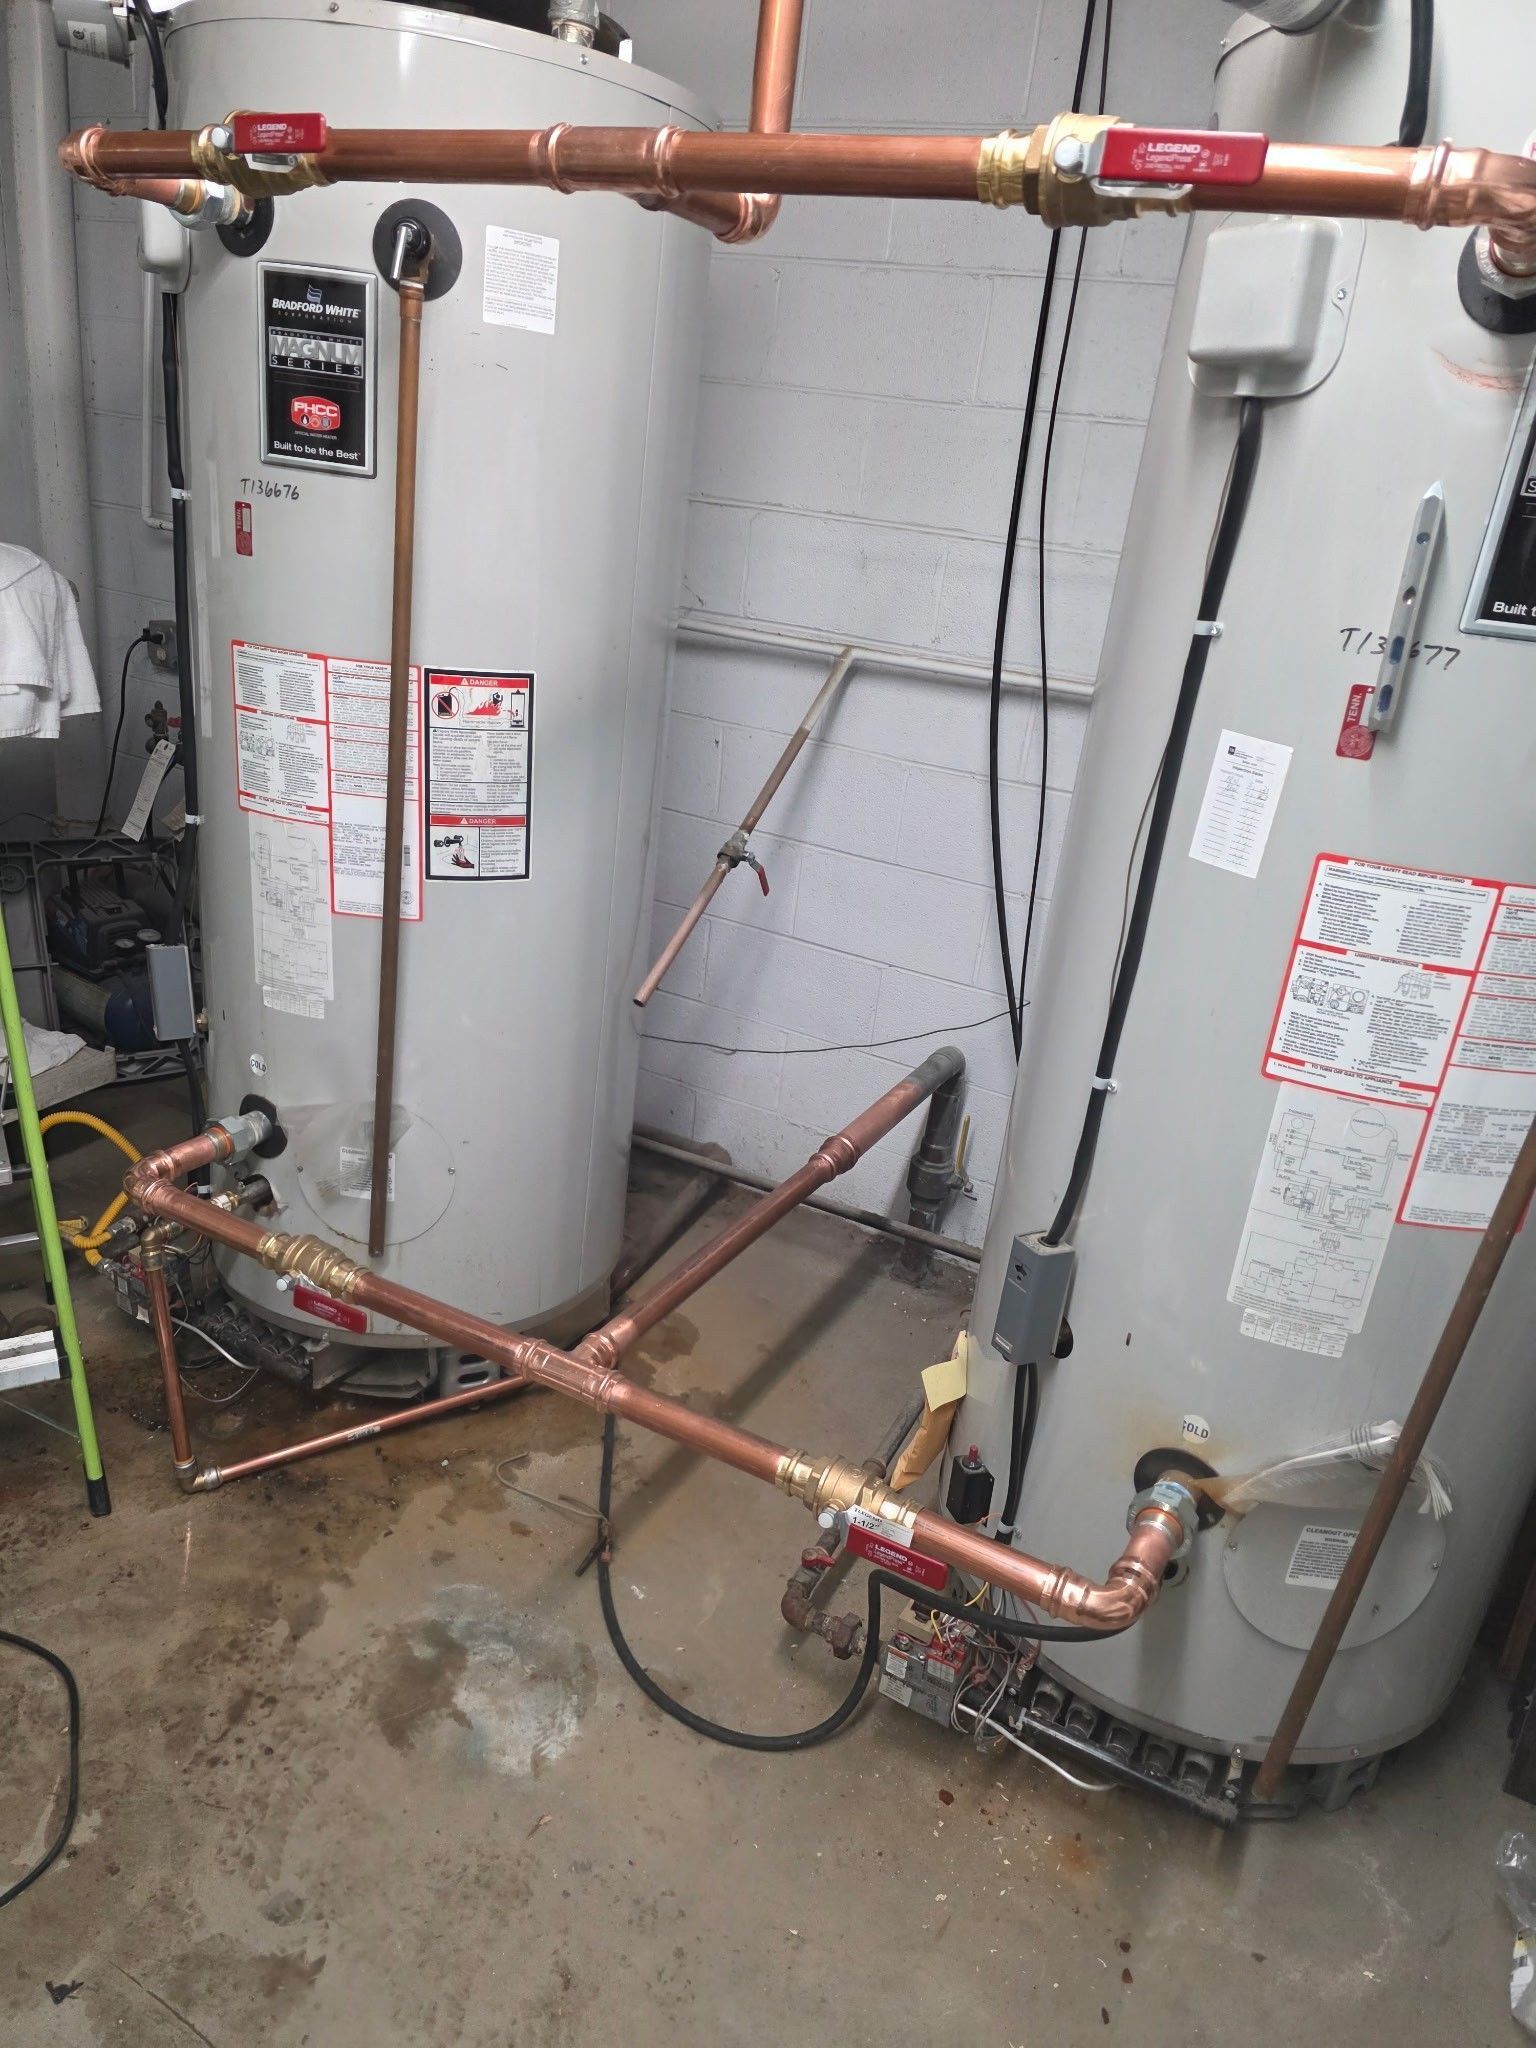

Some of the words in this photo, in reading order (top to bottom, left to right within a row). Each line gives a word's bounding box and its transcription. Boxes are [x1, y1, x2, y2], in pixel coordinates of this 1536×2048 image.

[257, 123, 288, 131] LEGEND
[1147, 142, 1201, 154] LEGEND
[272, 298, 323, 314] BRADFORD
[325, 304, 359, 318] WHITE
[278, 311, 352, 324] CORPORATION
[271, 335, 362, 365] MAGNUM
[272, 355, 360, 376] SERIES
[293, 401, 338, 417] PHCC
[273, 440, 292, 451] Built
[294, 443, 303, 452] to
[304, 445, 317, 454] be
[319, 447, 334, 457] the
[336, 449, 359, 460] Best
[240, 478, 300, 501] T136676
[1493, 601, 1528, 616] Built
[1340, 627, 1461, 671] T13677
[1346, 692, 1362, 722] TENN.
[1382, 866, 1402, 874] SAFETY
[250, 1058, 267, 1073] COLD
[1306, 1527, 1343, 1537] CLEANOUT
[874, 1543, 908, 1562] LEGEND
